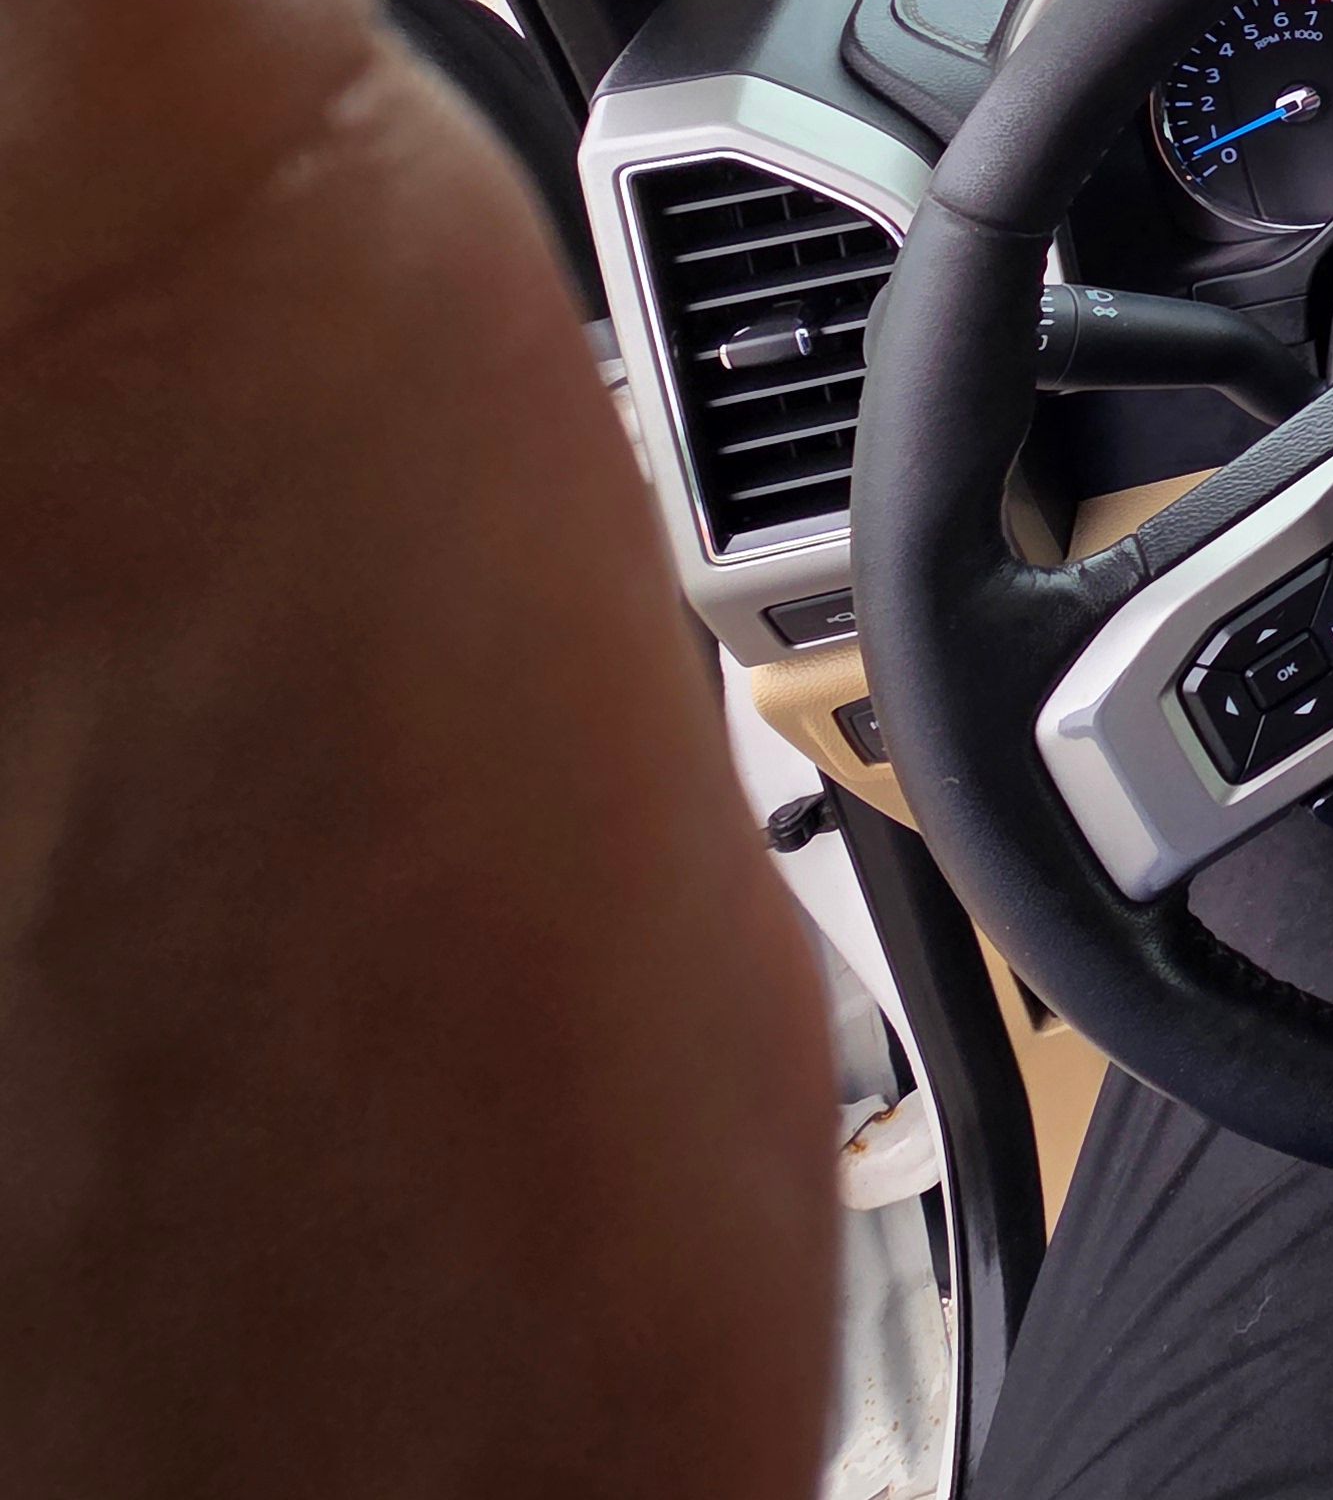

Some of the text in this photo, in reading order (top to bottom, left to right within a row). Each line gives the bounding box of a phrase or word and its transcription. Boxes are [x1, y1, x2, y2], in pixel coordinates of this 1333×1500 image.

[1273, 11, 1289, 27] 6
[1304, 10, 1318, 26] 7
[1243, 24, 1259, 40] 5
[1254, 29, 1323, 50] RPM X 1000
[1218, 42, 1234, 57] 4
[1205, 67, 1221, 83] 3
[1200, 96, 1215, 112] 2
[1210, 124, 1217, 139] 1
[1220, 147, 1237, 163] 0
[1276, 661, 1299, 682] OK
